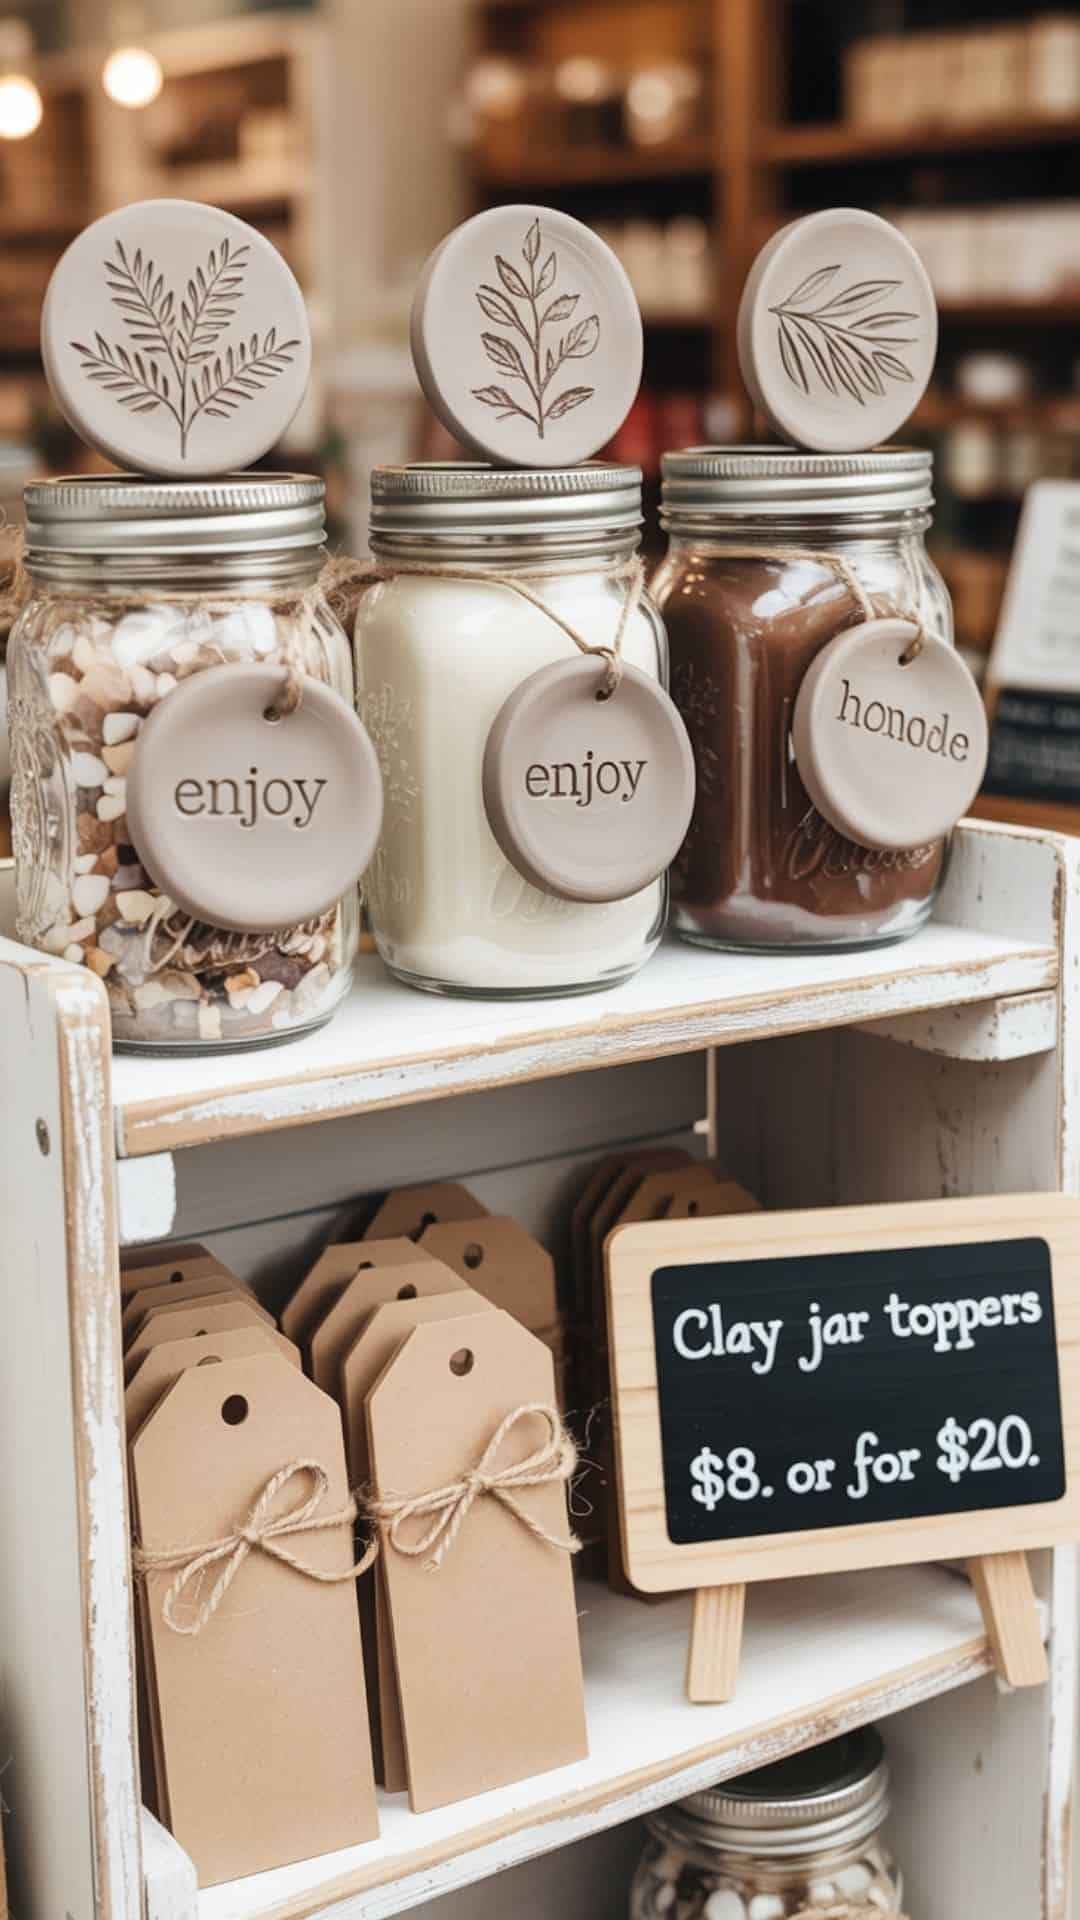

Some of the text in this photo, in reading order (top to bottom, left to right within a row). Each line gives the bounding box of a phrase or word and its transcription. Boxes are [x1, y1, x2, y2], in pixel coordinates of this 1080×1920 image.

[835, 680, 970, 763] honode
[174, 766, 328, 828] enjoy
[525, 751, 648, 807] enjoy
[673, 1291, 1043, 1374] Clay jar toppers
[690, 1415, 1040, 1511] $8. or for $20.
